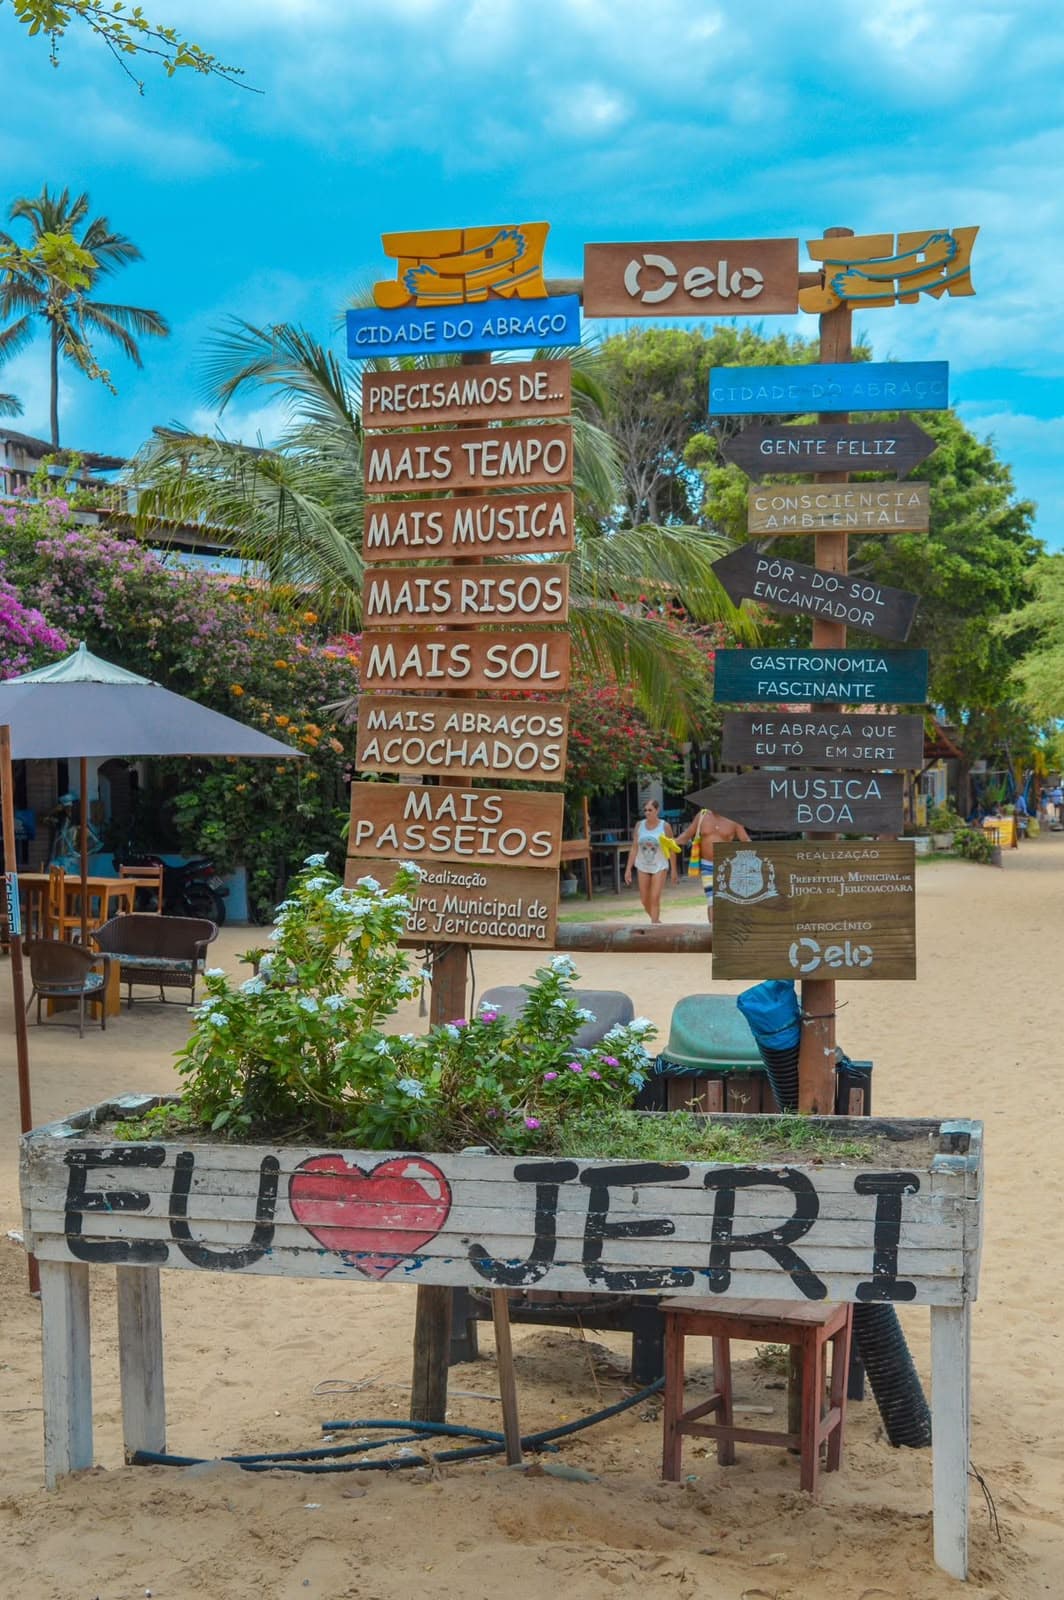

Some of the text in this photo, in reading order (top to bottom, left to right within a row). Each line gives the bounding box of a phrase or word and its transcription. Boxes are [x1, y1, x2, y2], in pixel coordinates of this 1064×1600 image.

[355, 314, 567, 344] CIDADE DO ABRAÇO
[369, 372, 564, 413] PRECISAMOS DE...
[712, 379, 946, 402] CIDADE DO ABRAÇO
[760, 438, 896, 456] GENTE FELIZ
[368, 439, 566, 483] MAIS TEMPO
[755, 490, 921, 511] CONSCIÊNCIA
[367, 502, 566, 548] MAIS MÚSICA
[765, 511, 905, 529] AMBIENTAL
[367, 576, 563, 616] MAIS RISOS
[753, 581, 876, 627] ENCANTADOR
[849, 582, 886, 606] SOL
[366, 643, 560, 680] MAIS SOL
[750, 656, 888, 673] GASTRONOMIA
[757, 681, 876, 698] FASCINANTE
[367, 709, 564, 739] MAIS ABRAÇOS
[751, 723, 897, 740] ME ABRAÇA QUE
[361, 737, 562, 771] ACOCHADOS
[755, 741, 896, 760] EU TÔ EM JERI
[770, 779, 882, 800] MUSICA
[403, 791, 503, 824] MAIS
[797, 803, 854, 824] BOA
[355, 820, 552, 858] PASSEIOS
[796, 850, 881, 861] REALIZAÇÃO
[419, 869, 487, 888] Realização
[442, 894, 522, 920] Municipal
[527, 900, 548, 919] de
[406, 913, 546, 939] de Jericoacoara
[796, 920, 872, 931] PATROCÍNIO
[63, 1145, 921, 1302] EU JERI
